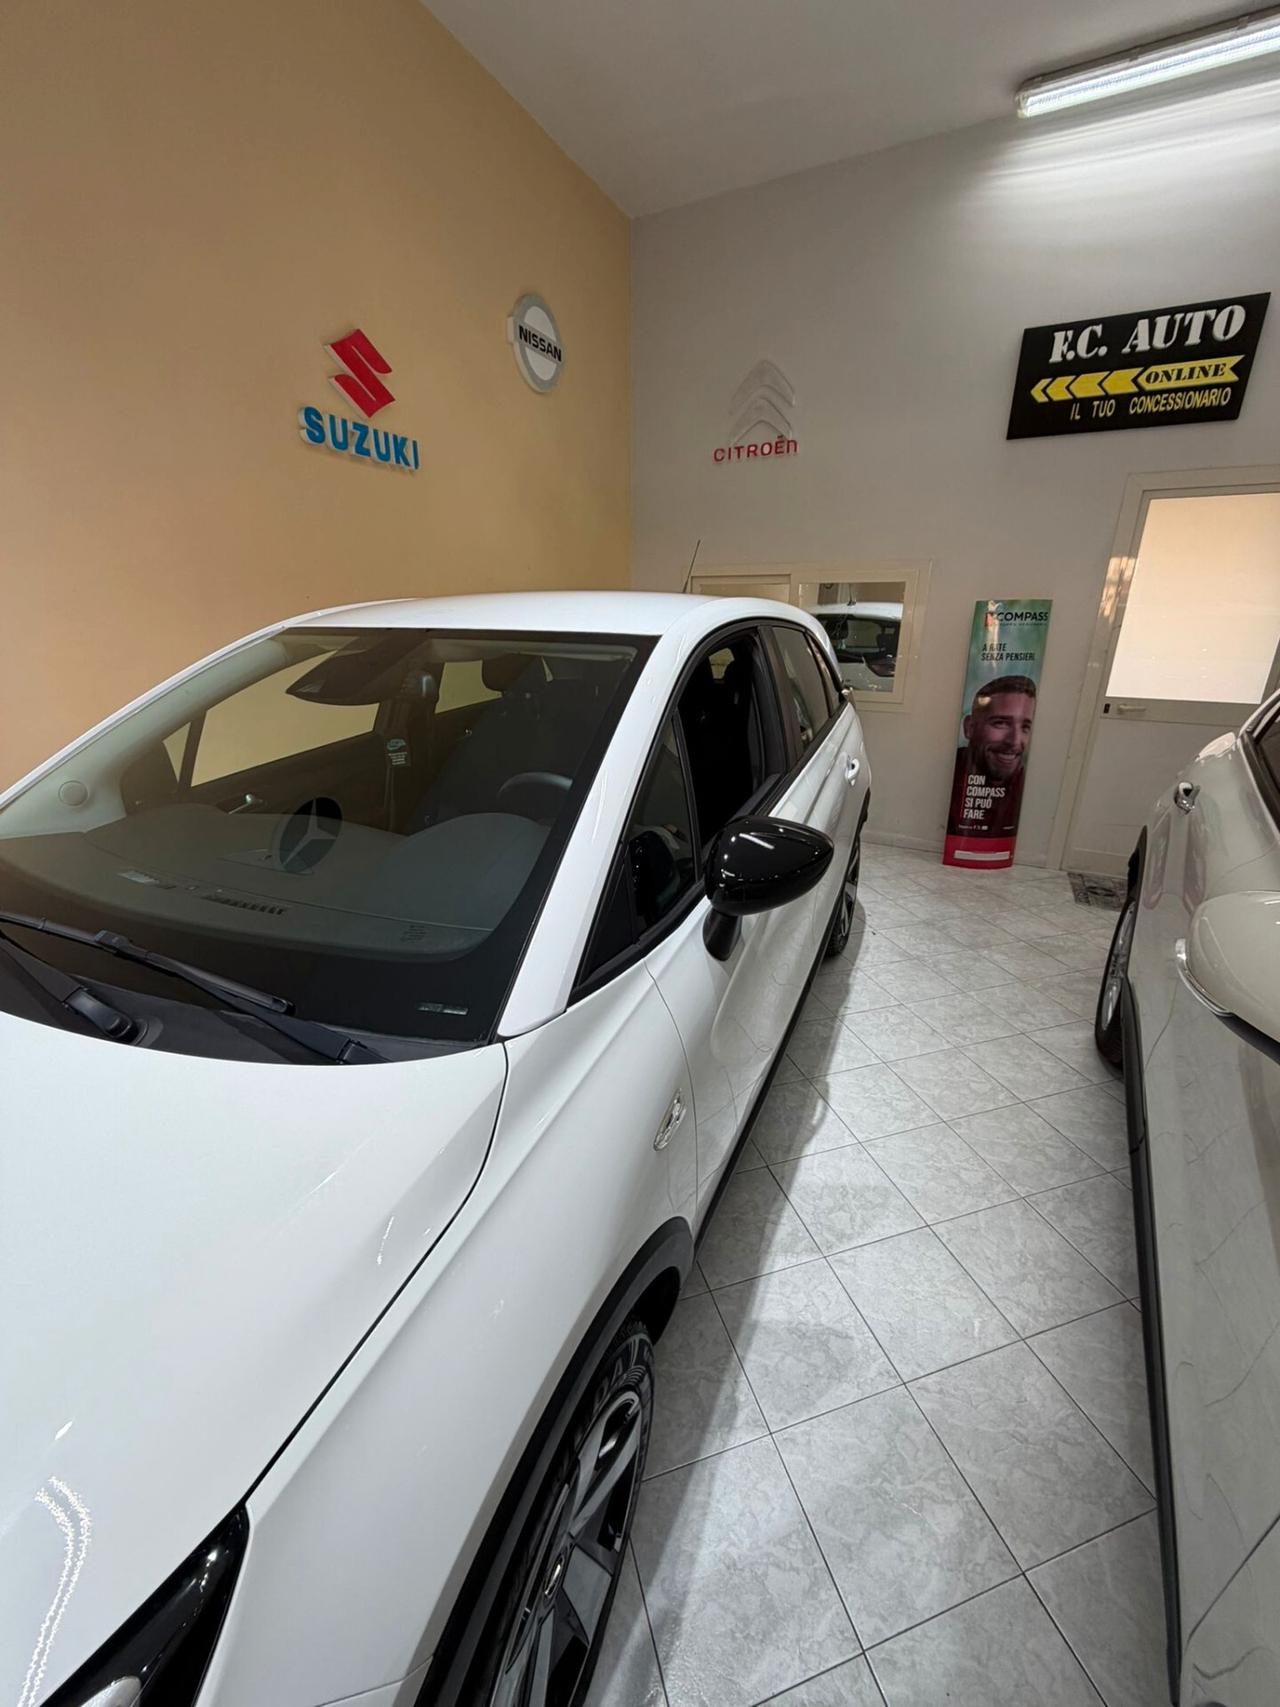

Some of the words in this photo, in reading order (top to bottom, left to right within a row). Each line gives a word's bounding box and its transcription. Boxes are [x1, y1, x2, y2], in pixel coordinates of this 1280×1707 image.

[1049, 324, 1108, 363] F.C.
[1121, 304, 1247, 354] AUTO
[519, 324, 562, 362] NISSAN
[1145, 363, 1227, 384] ONLINE
[1070, 402, 1081, 421] IL
[1092, 399, 1116, 418] TUO
[1129, 387, 1232, 415] CONCESSIONARIO
[299, 405, 420, 470] SUZUKI
[997, 611, 1049, 622] COMPASS
[967, 774, 986, 785] CON
[966, 785, 1006, 798] COMPASS
[964, 797, 974, 808] SI
[963, 808, 985, 820] FARE
